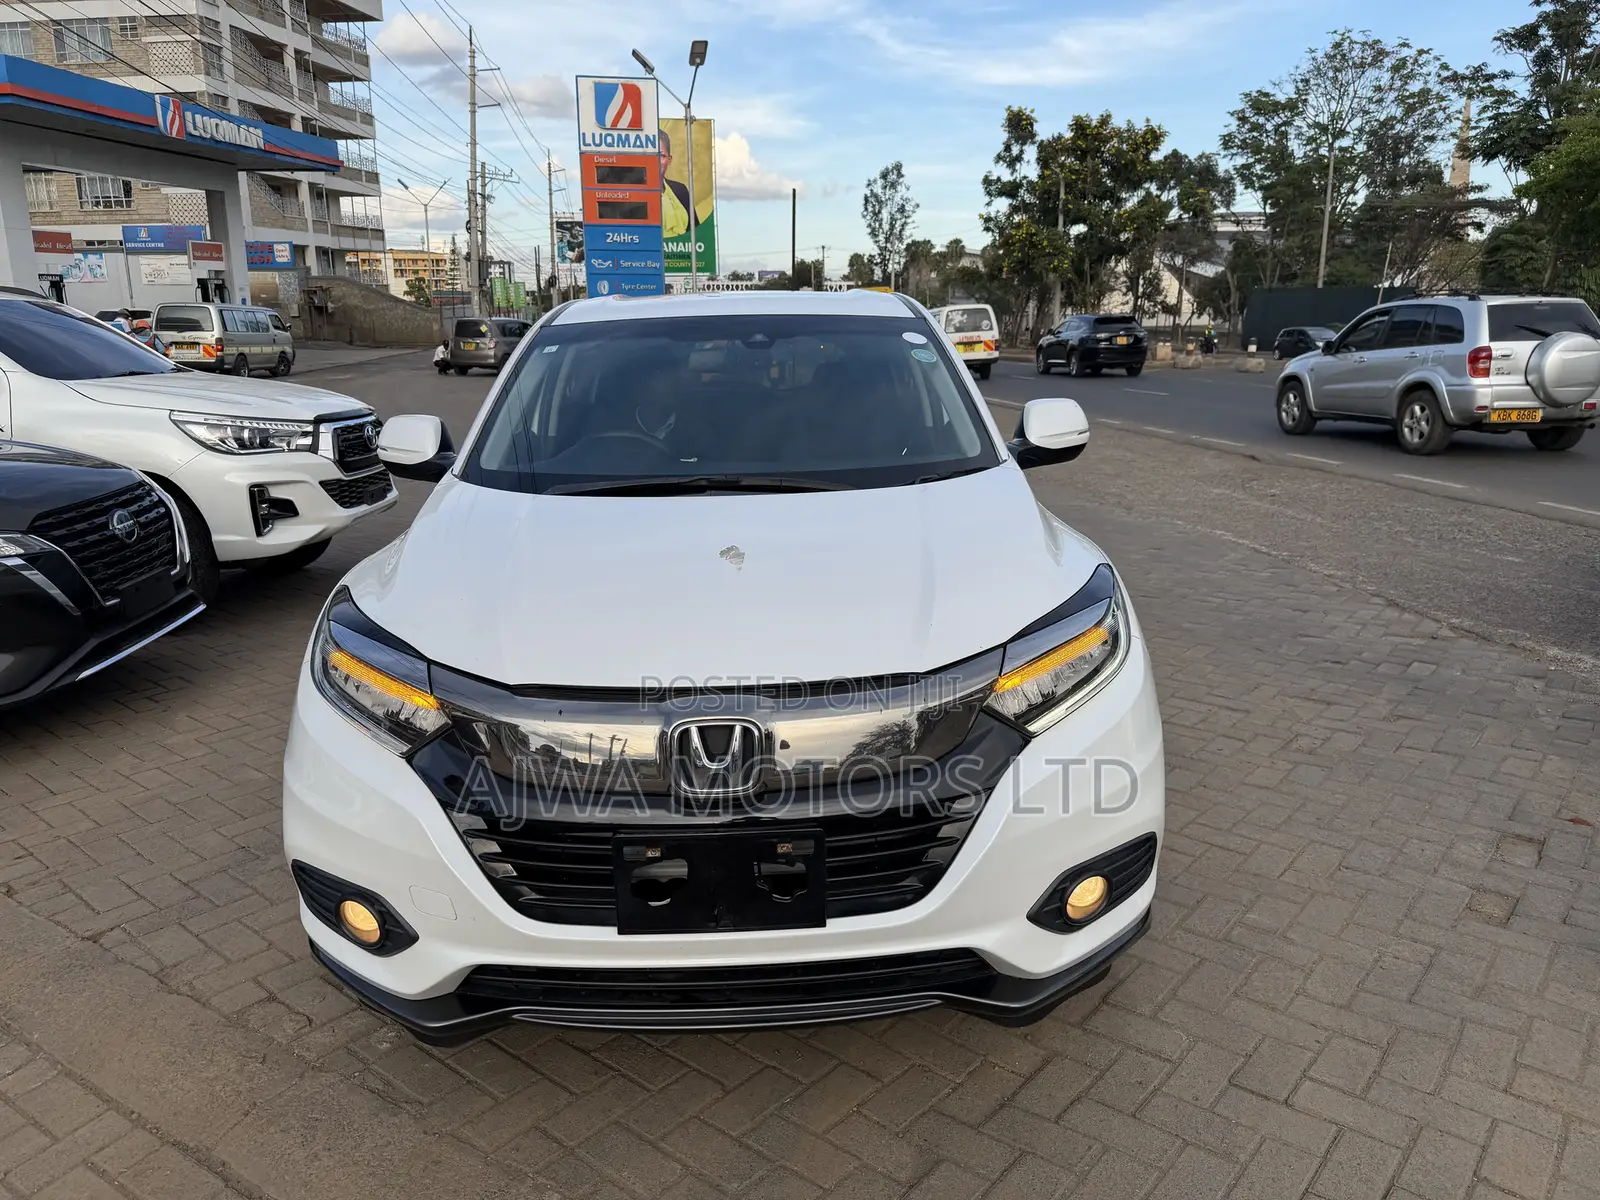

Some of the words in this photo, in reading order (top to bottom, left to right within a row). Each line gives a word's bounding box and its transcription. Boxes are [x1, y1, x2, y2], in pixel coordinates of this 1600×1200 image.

[184, 111, 265, 150] LUQMAN
[581, 132, 657, 149] LUQMAN
[594, 155, 616, 163] Diesel
[595, 191, 629, 199] Unleaded
[605, 232, 640, 243] 24Hrs
[620, 260, 646, 268] Service
[647, 260, 660, 270] Bay
[621, 283, 636, 292] Tyre
[636, 283, 657, 291] Center
[1496, 410, 1513, 421] KBK
[1516, 410, 1537, 420] 868G
